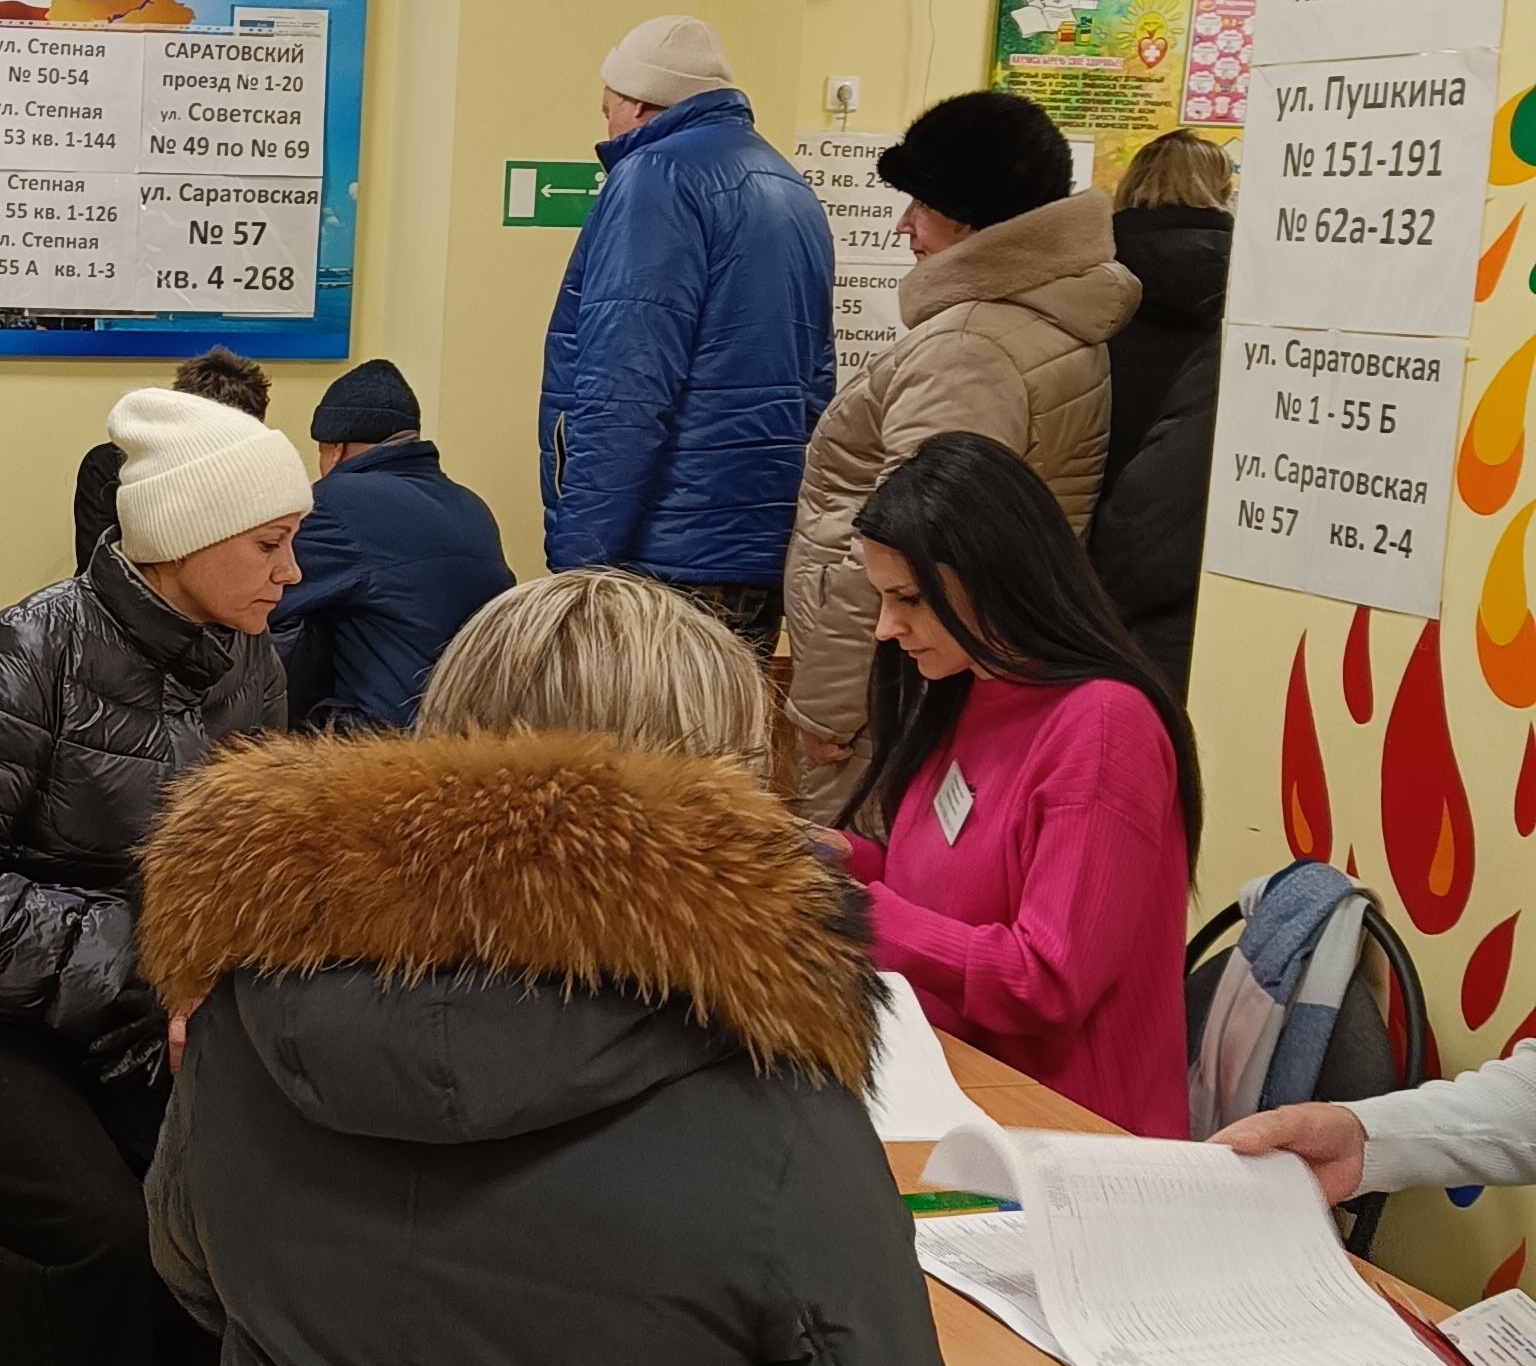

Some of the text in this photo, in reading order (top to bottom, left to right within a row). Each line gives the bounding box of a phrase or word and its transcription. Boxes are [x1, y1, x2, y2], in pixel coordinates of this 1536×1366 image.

[28, 38, 105, 57] Степная
[165, 42, 303, 63] САРАТОВСКИЙ
[9, 66, 89, 85] № 50-54
[163, 74, 303, 92] проезд № 1-20
[1277, 76, 1465, 121] ул. Пушкина
[26, 101, 102, 119] Степная
[161, 103, 300, 124] ул. Советская
[5, 129, 25, 145] 53
[33, 134, 58, 146] кв.
[66, 132, 116, 148] 1-144
[151, 135, 309, 158] № 49 по № 69
[795, 141, 886, 158] л. Степна
[1283, 140, 1442, 177] № 151-191
[8, 171, 84, 192] Степная
[832, 175, 859, 188] кв.
[141, 183, 318, 206] ул. Саратовская
[6, 203, 27, 218] 55
[34, 208, 60, 219] кв.
[68, 205, 117, 222] 1-126
[820, 200, 893, 218] тепная
[190, 221, 266, 245] № 57
[1277, 208, 1434, 245] № 62а-132
[23, 232, 98, 249] Степная
[840, 231, 901, 250] -171/2
[26, 260, 38, 275] А
[55, 265, 80, 277] кв.
[88, 263, 114, 278] 1-3
[157, 266, 294, 290] кв. 4 -268
[834, 276, 900, 289] шевско
[834, 327, 896, 341] льский
[1245, 340, 1440, 382] ул. Саратовская
[1276, 391, 1301, 422] №
[1309, 396, 1319, 424] 1
[1342, 400, 1370, 431] 55
[1380, 404, 1396, 433] Б
[1236, 454, 1427, 504] ул. Саратовская
[1238, 500, 1412, 558] № 57 кв. 2-4
